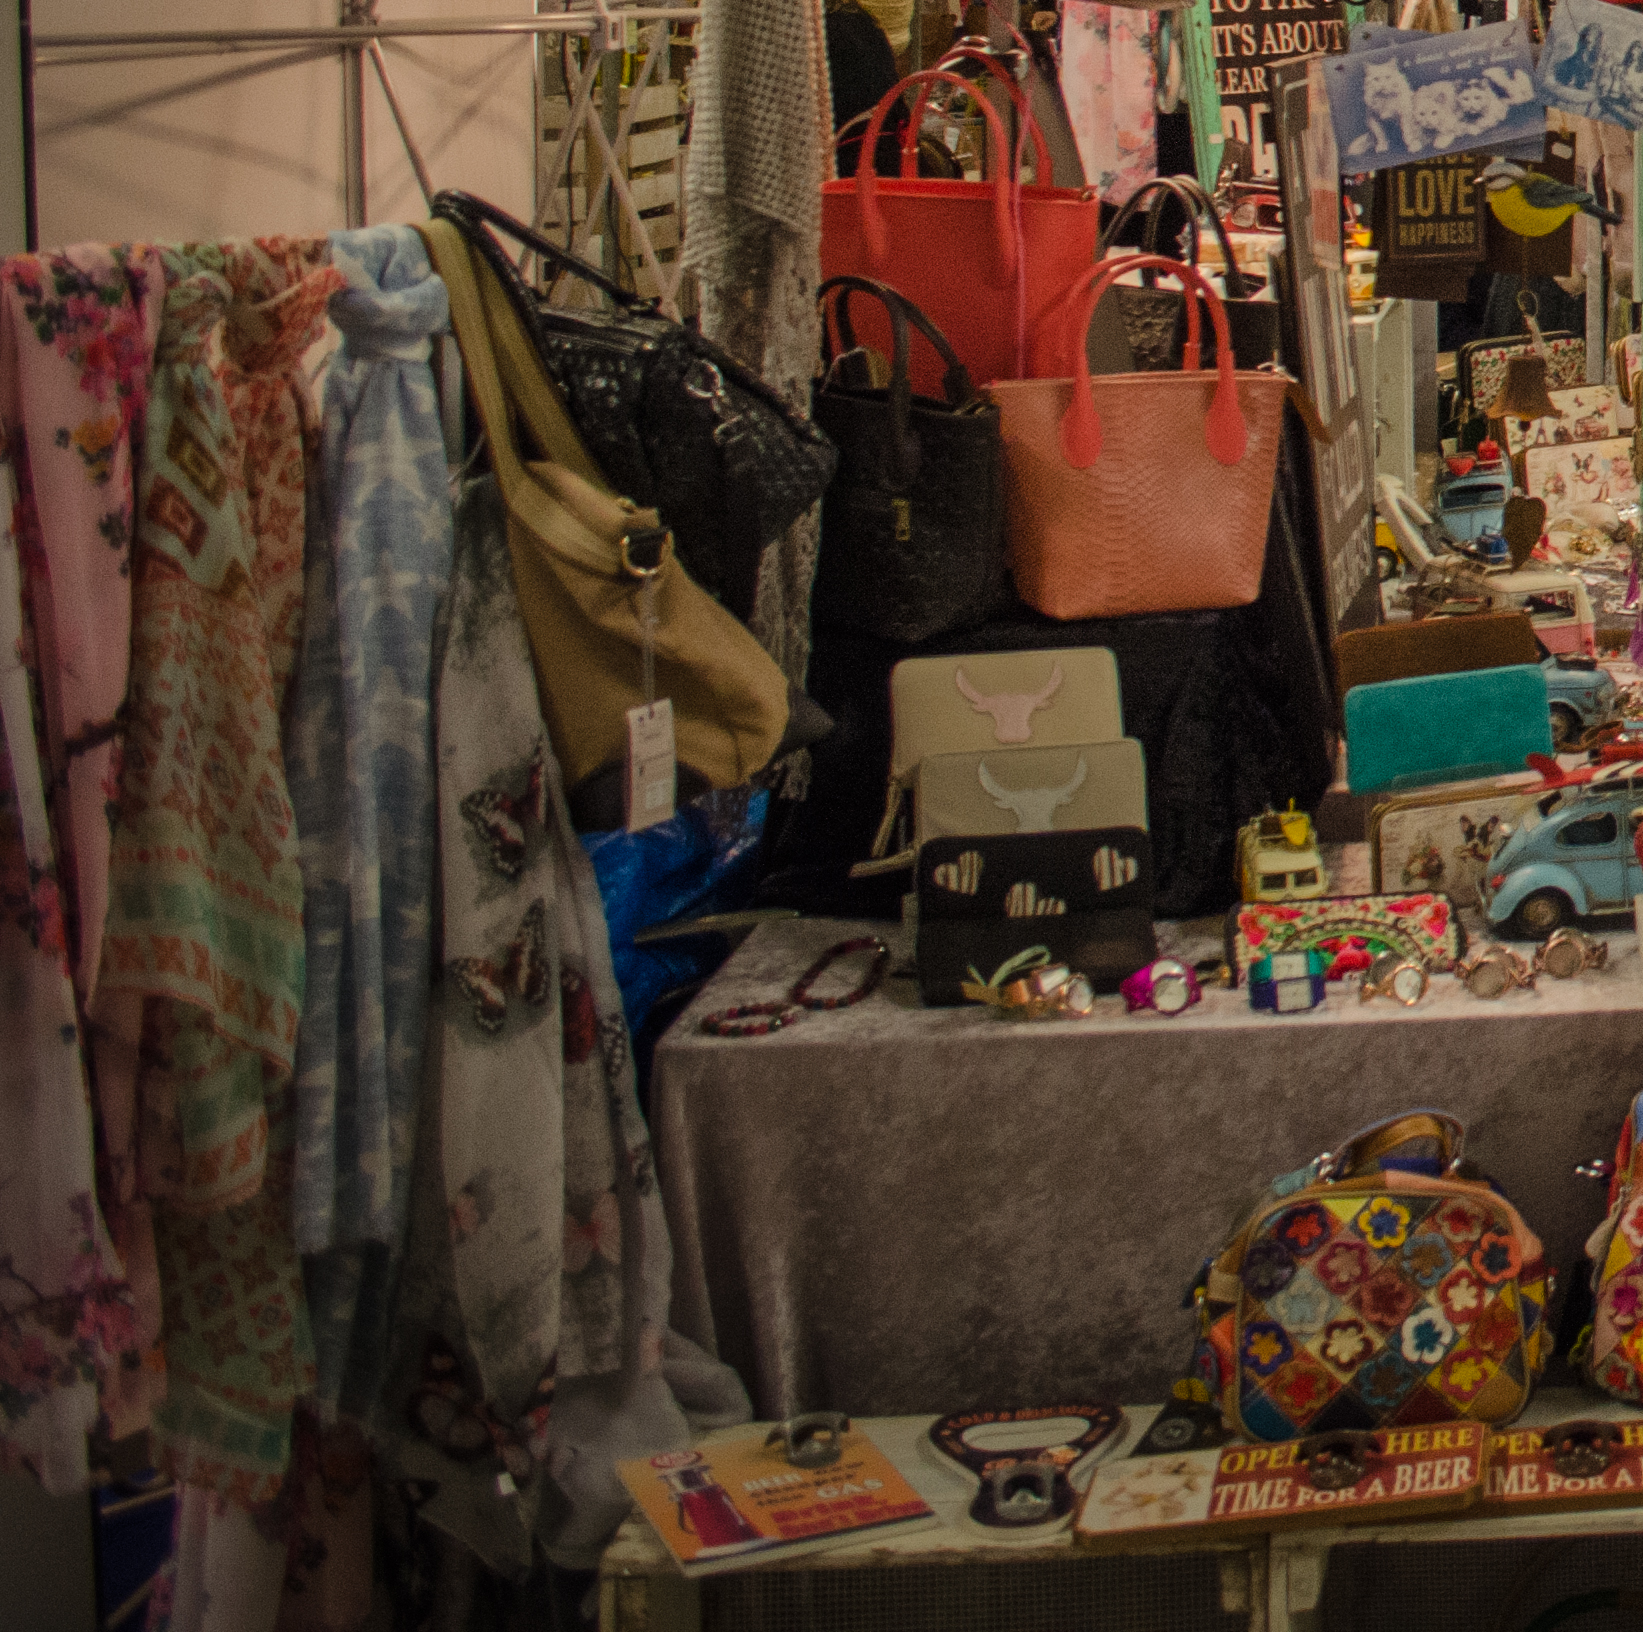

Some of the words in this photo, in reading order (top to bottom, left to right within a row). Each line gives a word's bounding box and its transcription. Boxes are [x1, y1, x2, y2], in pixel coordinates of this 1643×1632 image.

[1211, 22, 1257, 58] IT'S
[1260, 18, 1344, 55] ABOUT
[1214, 65, 1270, 95] LEAR
[1400, 168, 1475, 219] LOVE
[1399, 222, 1476, 247] HAPPINESS
[1385, 1428, 1475, 1456] HERE
[1214, 1478, 1293, 1516] TIME
[1297, 1486, 1358, 1507] FOR
[1365, 1478, 1386, 1499] A
[1392, 1455, 1472, 1495] BEER
[1545, 1471, 1608, 1493] FOR
[1614, 1467, 1635, 1489] A
